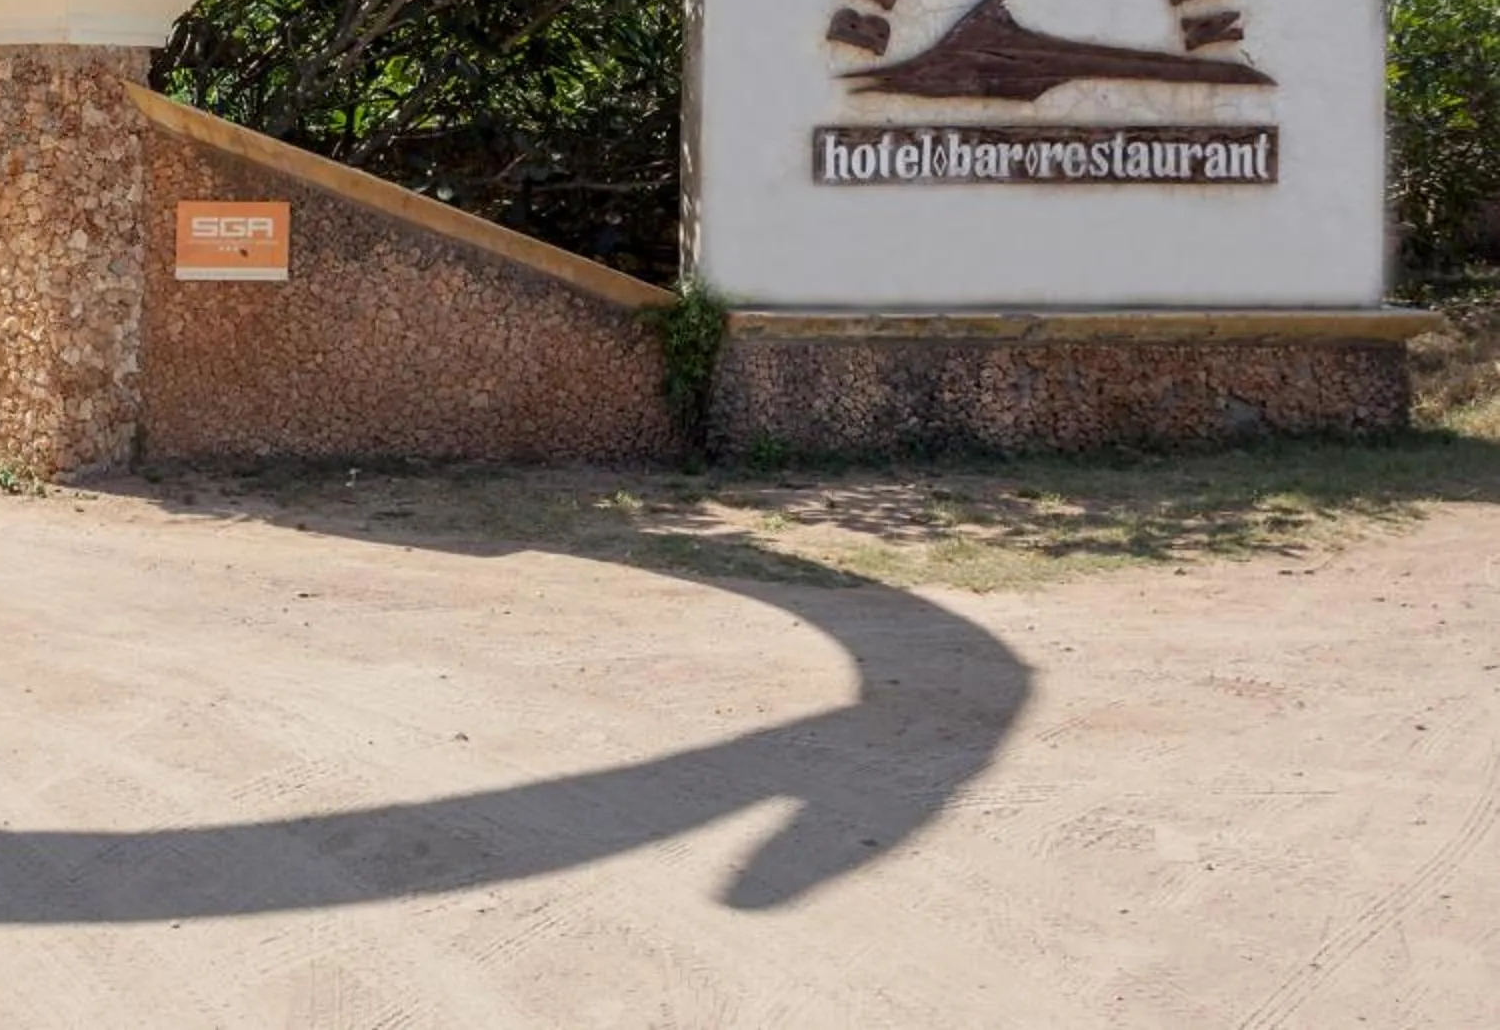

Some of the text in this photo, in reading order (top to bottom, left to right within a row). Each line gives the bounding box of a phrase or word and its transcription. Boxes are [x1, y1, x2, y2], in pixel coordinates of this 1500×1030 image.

[824, 131, 1270, 180] hotel bar restaurant
[191, 217, 274, 238] SGA
